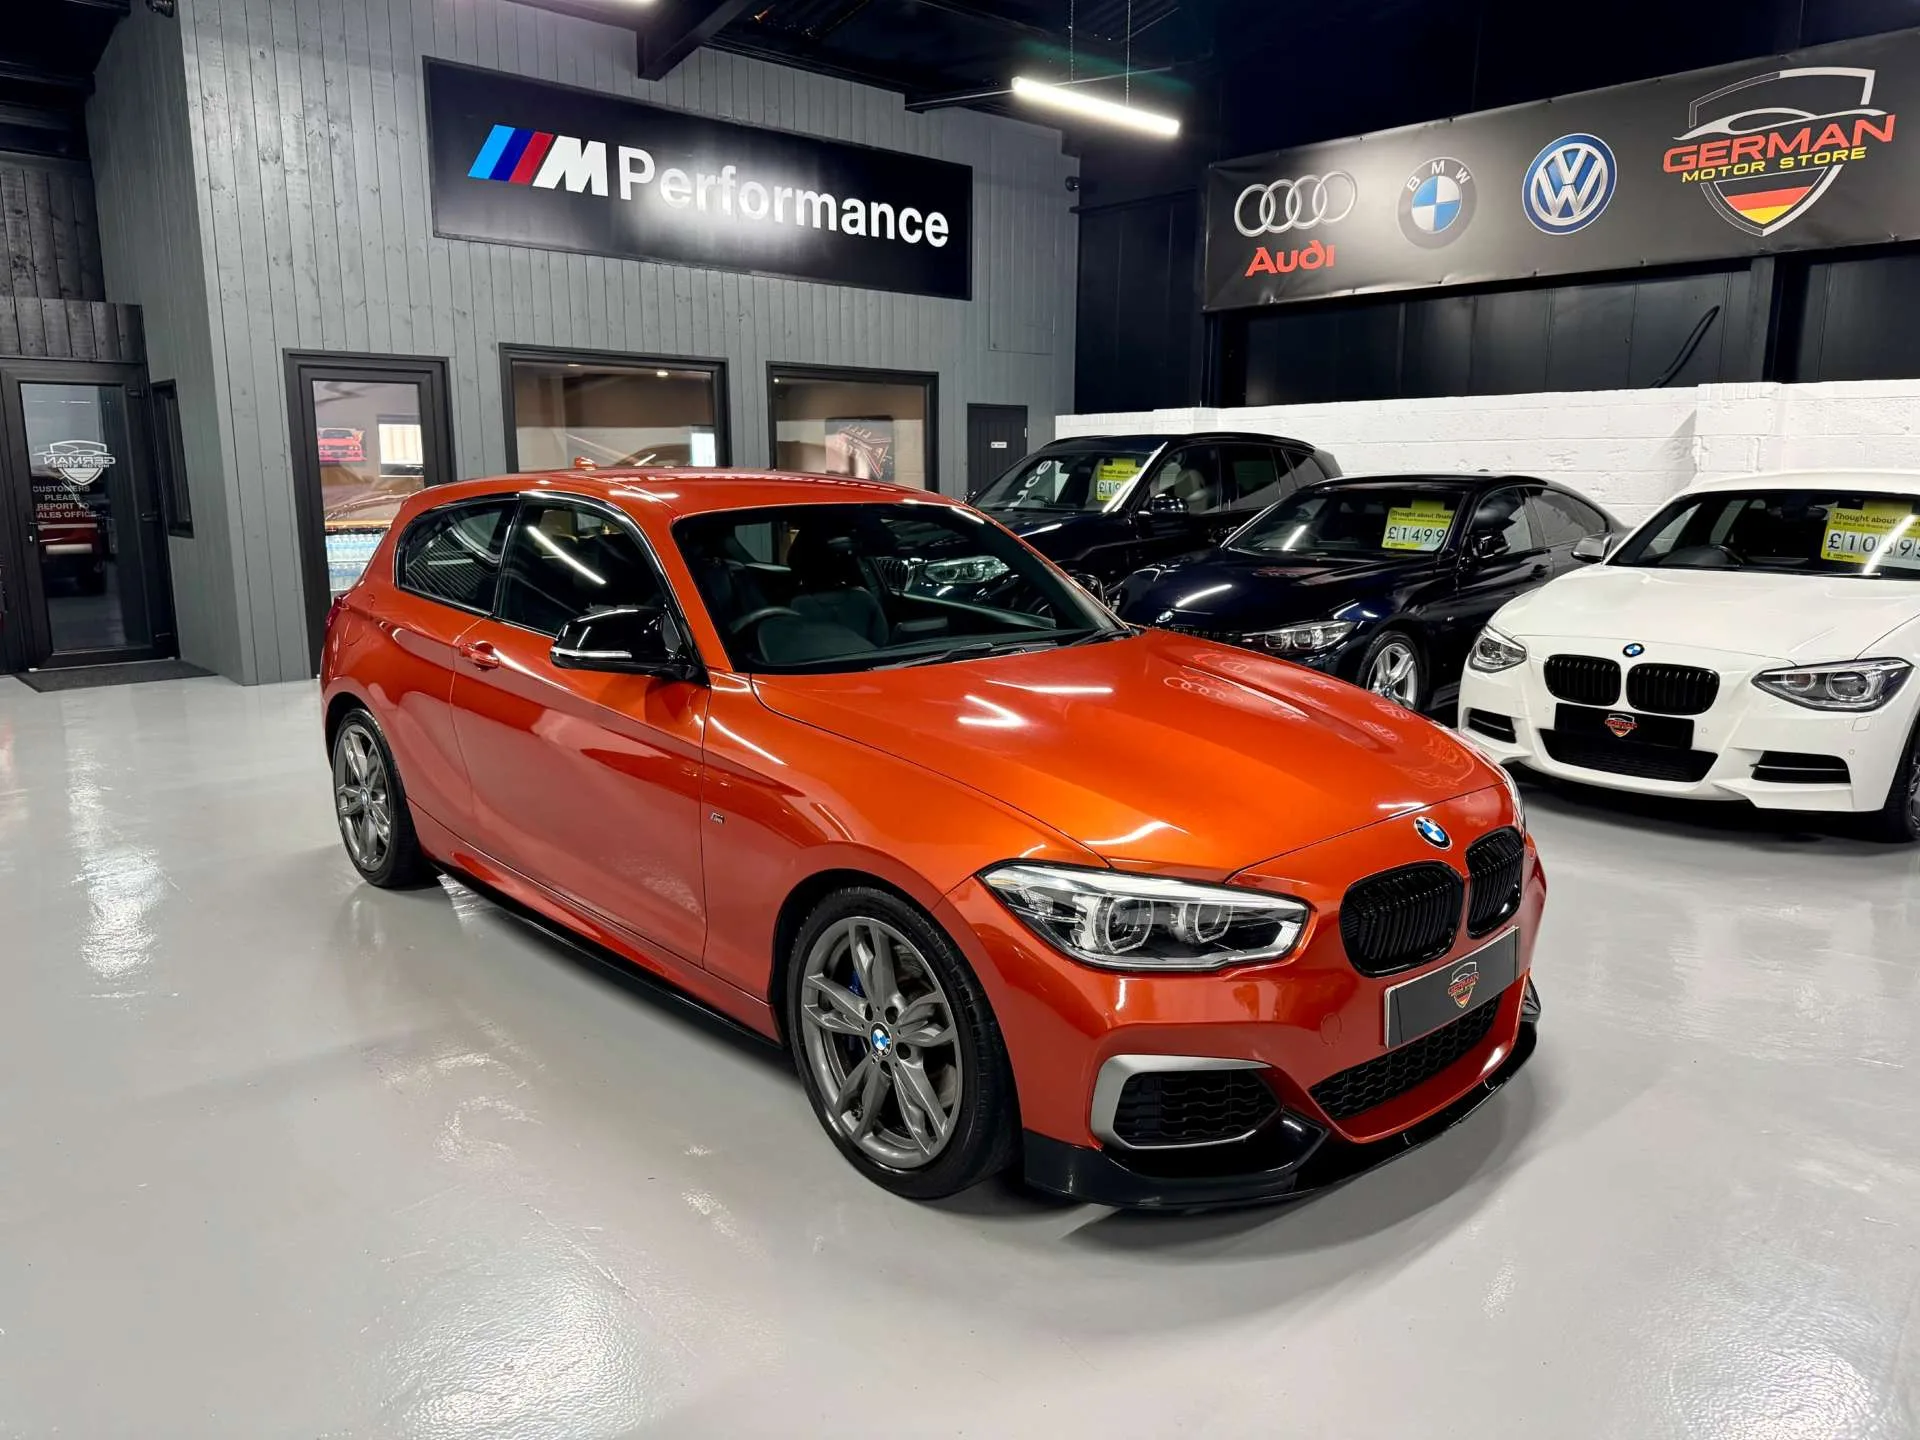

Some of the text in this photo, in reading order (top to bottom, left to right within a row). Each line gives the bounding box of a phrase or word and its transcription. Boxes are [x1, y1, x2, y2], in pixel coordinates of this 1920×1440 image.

[1662, 114, 1896, 174] GERMAN
[1406, 159, 1471, 192] BMW
[1681, 147, 1867, 183] MOTOR STORE
[533, 135, 949, 248] M Performance
[1244, 240, 1335, 277] Audi
[36, 502, 75, 510] REPORT
[36, 511, 62, 519] ALES
[1834, 512, 1869, 522] Thought
[1871, 516, 1896, 524] about
[1387, 526, 1445, 543] £1499
[1828, 533, 1920, 557] £109
